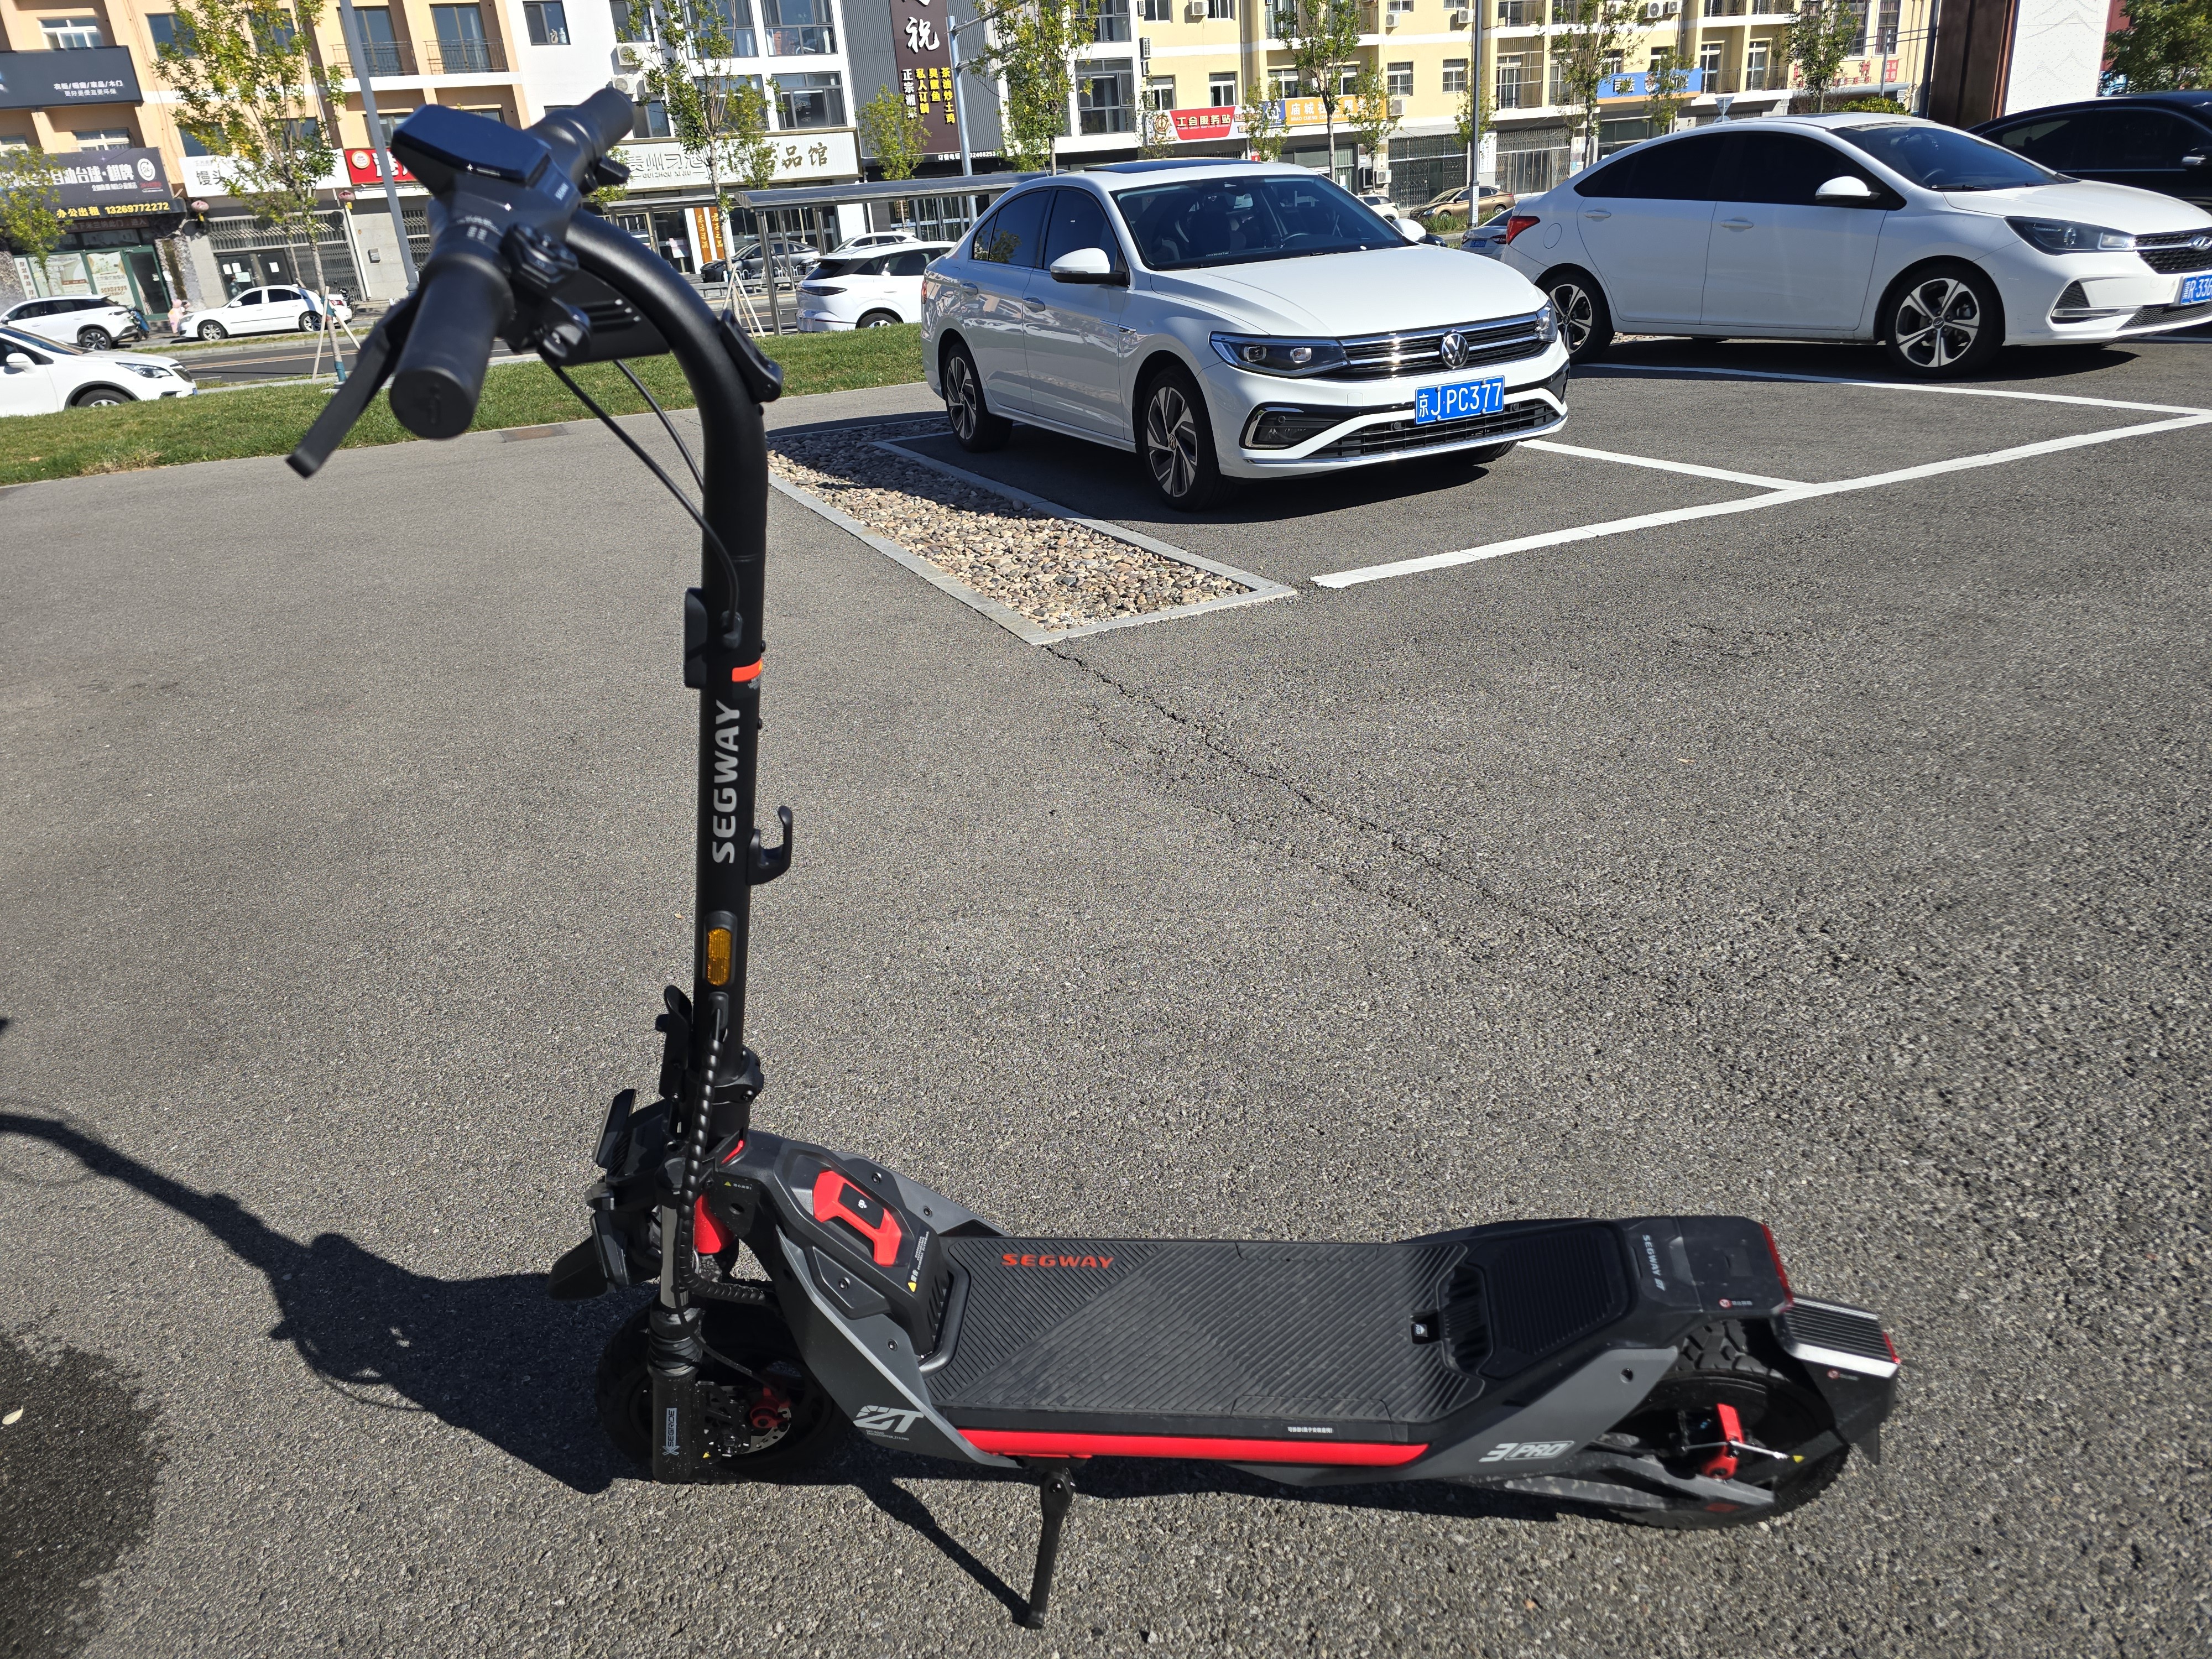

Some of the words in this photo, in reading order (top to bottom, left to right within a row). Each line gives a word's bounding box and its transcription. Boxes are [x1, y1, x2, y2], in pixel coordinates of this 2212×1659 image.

[901, 0, 940, 53] 祝
[941, 67, 955, 123] 茶油炒土鸡
[1177, 114, 1231, 127] 工会服务站
[57, 206, 100, 218] 办公出租
[105, 202, 170, 215] 13269772272
[712, 700, 740, 863] SEGWAY
[1000, 1253, 1114, 1269] SEGWAY
[1642, 1235, 1661, 1276] SEGWAY
[1478, 1443, 1519, 1463] 3
[1509, 1443, 1569, 1458] PRO
